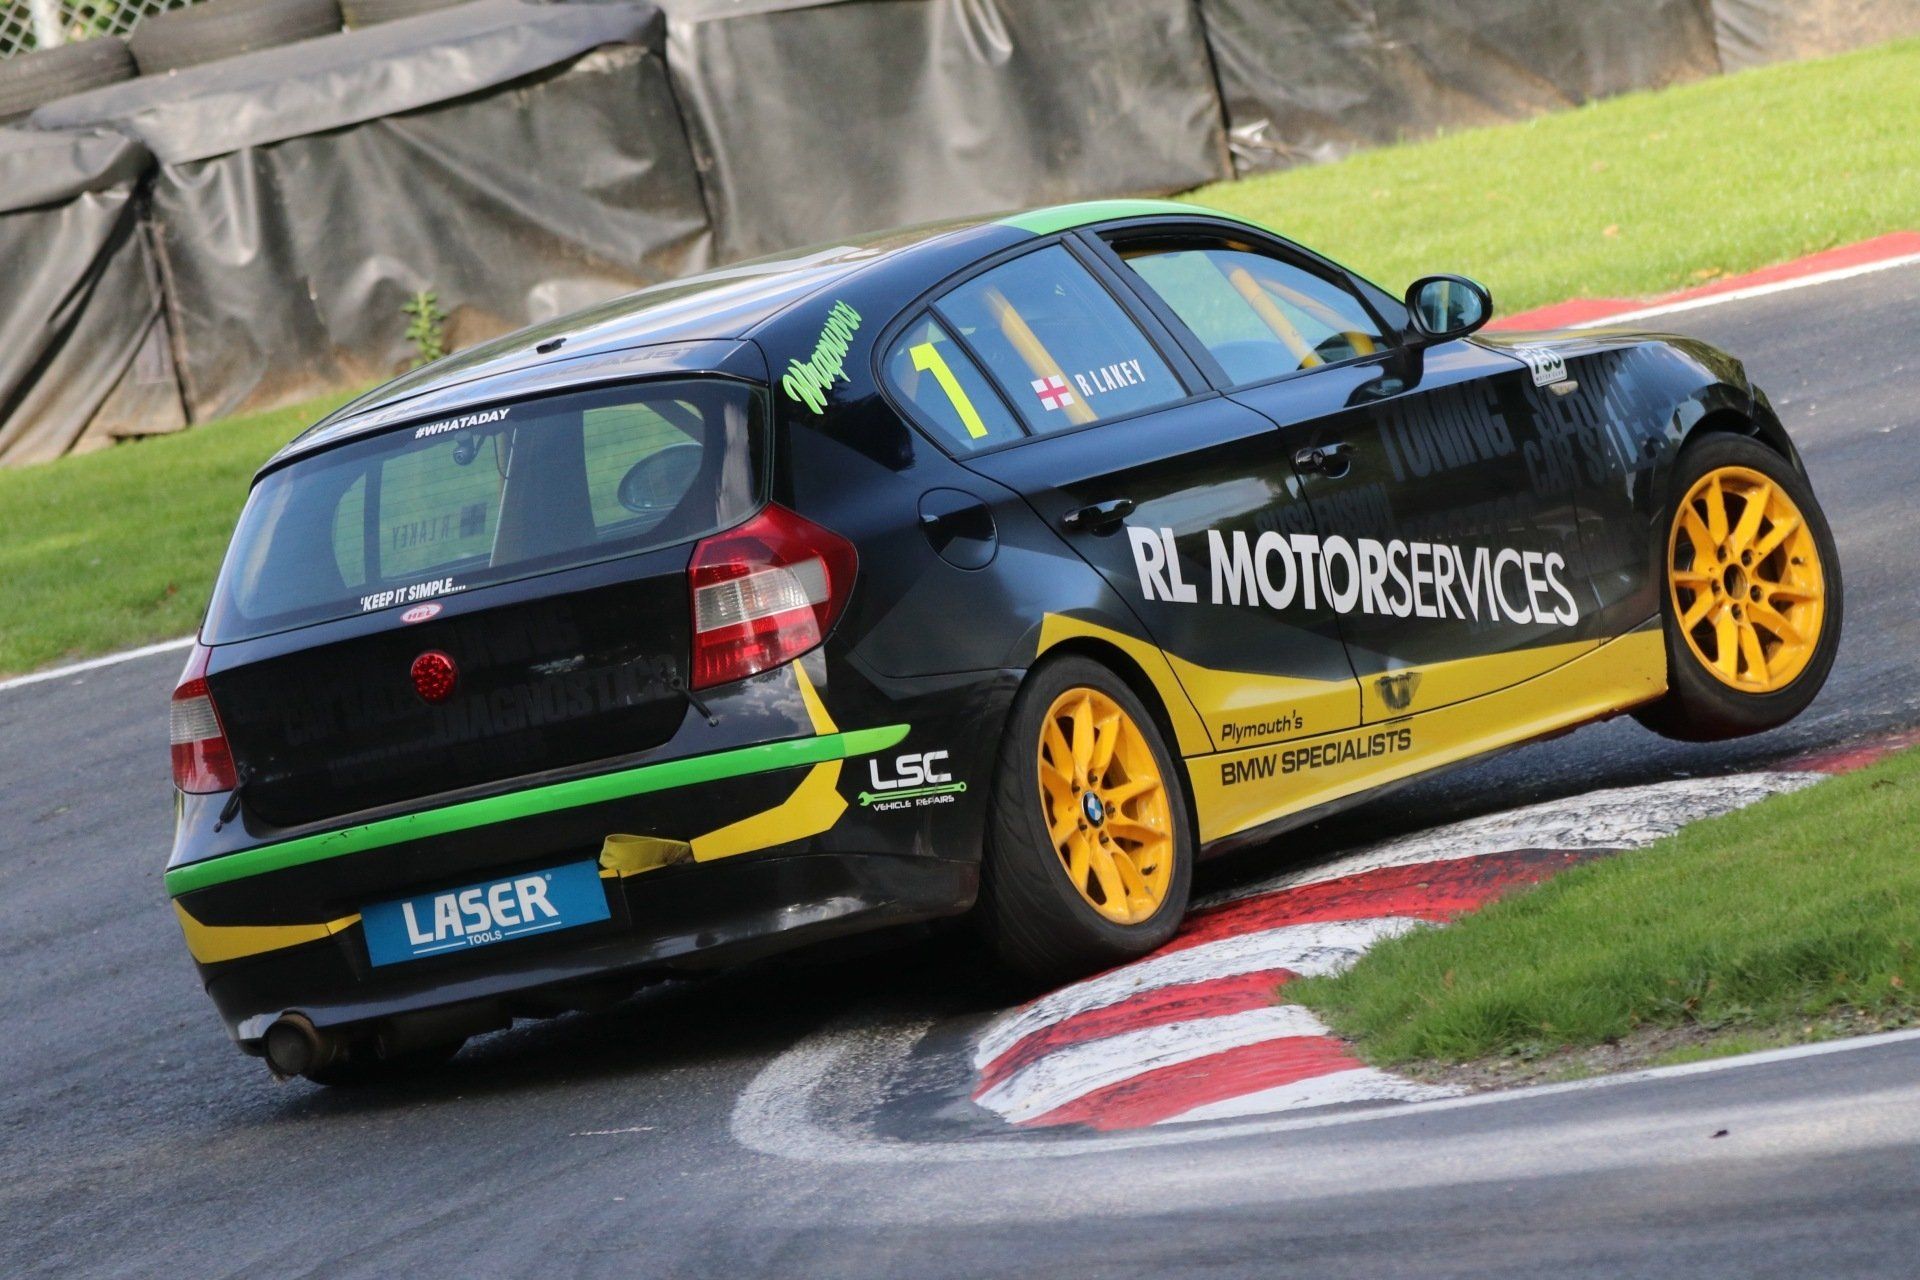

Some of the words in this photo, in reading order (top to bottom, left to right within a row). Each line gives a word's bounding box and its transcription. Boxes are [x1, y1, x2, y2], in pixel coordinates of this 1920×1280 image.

[909, 342, 988, 439] 1
[1074, 373, 1094, 397] R
[1088, 359, 1146, 393] LAKEY
[414, 408, 510, 440] #WHATADAY
[395, 587, 407, 603] IT
[1127, 527, 1197, 603] RL
[1208, 530, 1580, 627] MOTORSERVICES
[1221, 709, 1303, 744] Plymouth's
[869, 750, 952, 790] LSC
[1221, 754, 1277, 786] BMW
[1281, 727, 1412, 774] SPECIALISTS
[873, 801, 911, 811] VEHICLE
[916, 795, 954, 806] REPAIRS
[402, 876, 558, 945] LASER
[467, 930, 503, 945] TOOLS
